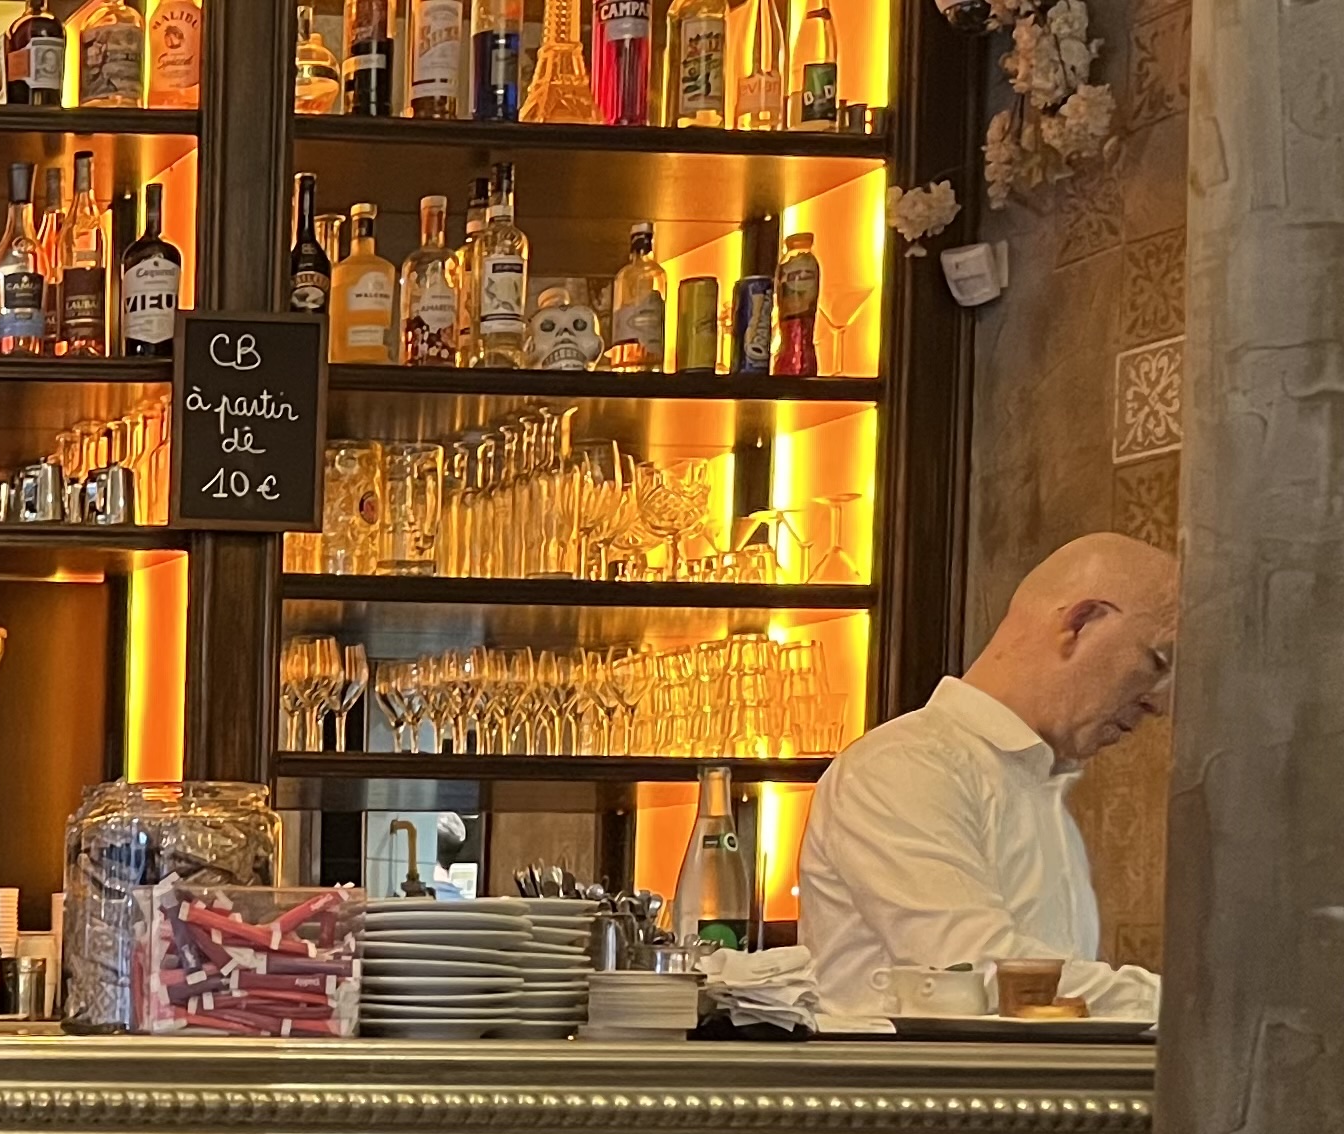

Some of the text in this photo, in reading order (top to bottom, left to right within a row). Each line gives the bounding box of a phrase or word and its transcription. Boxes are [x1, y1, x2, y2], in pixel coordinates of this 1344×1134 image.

[125, 293, 176, 314] VIEU
[209, 333, 262, 371] CB
[186, 385, 300, 435] à partir
